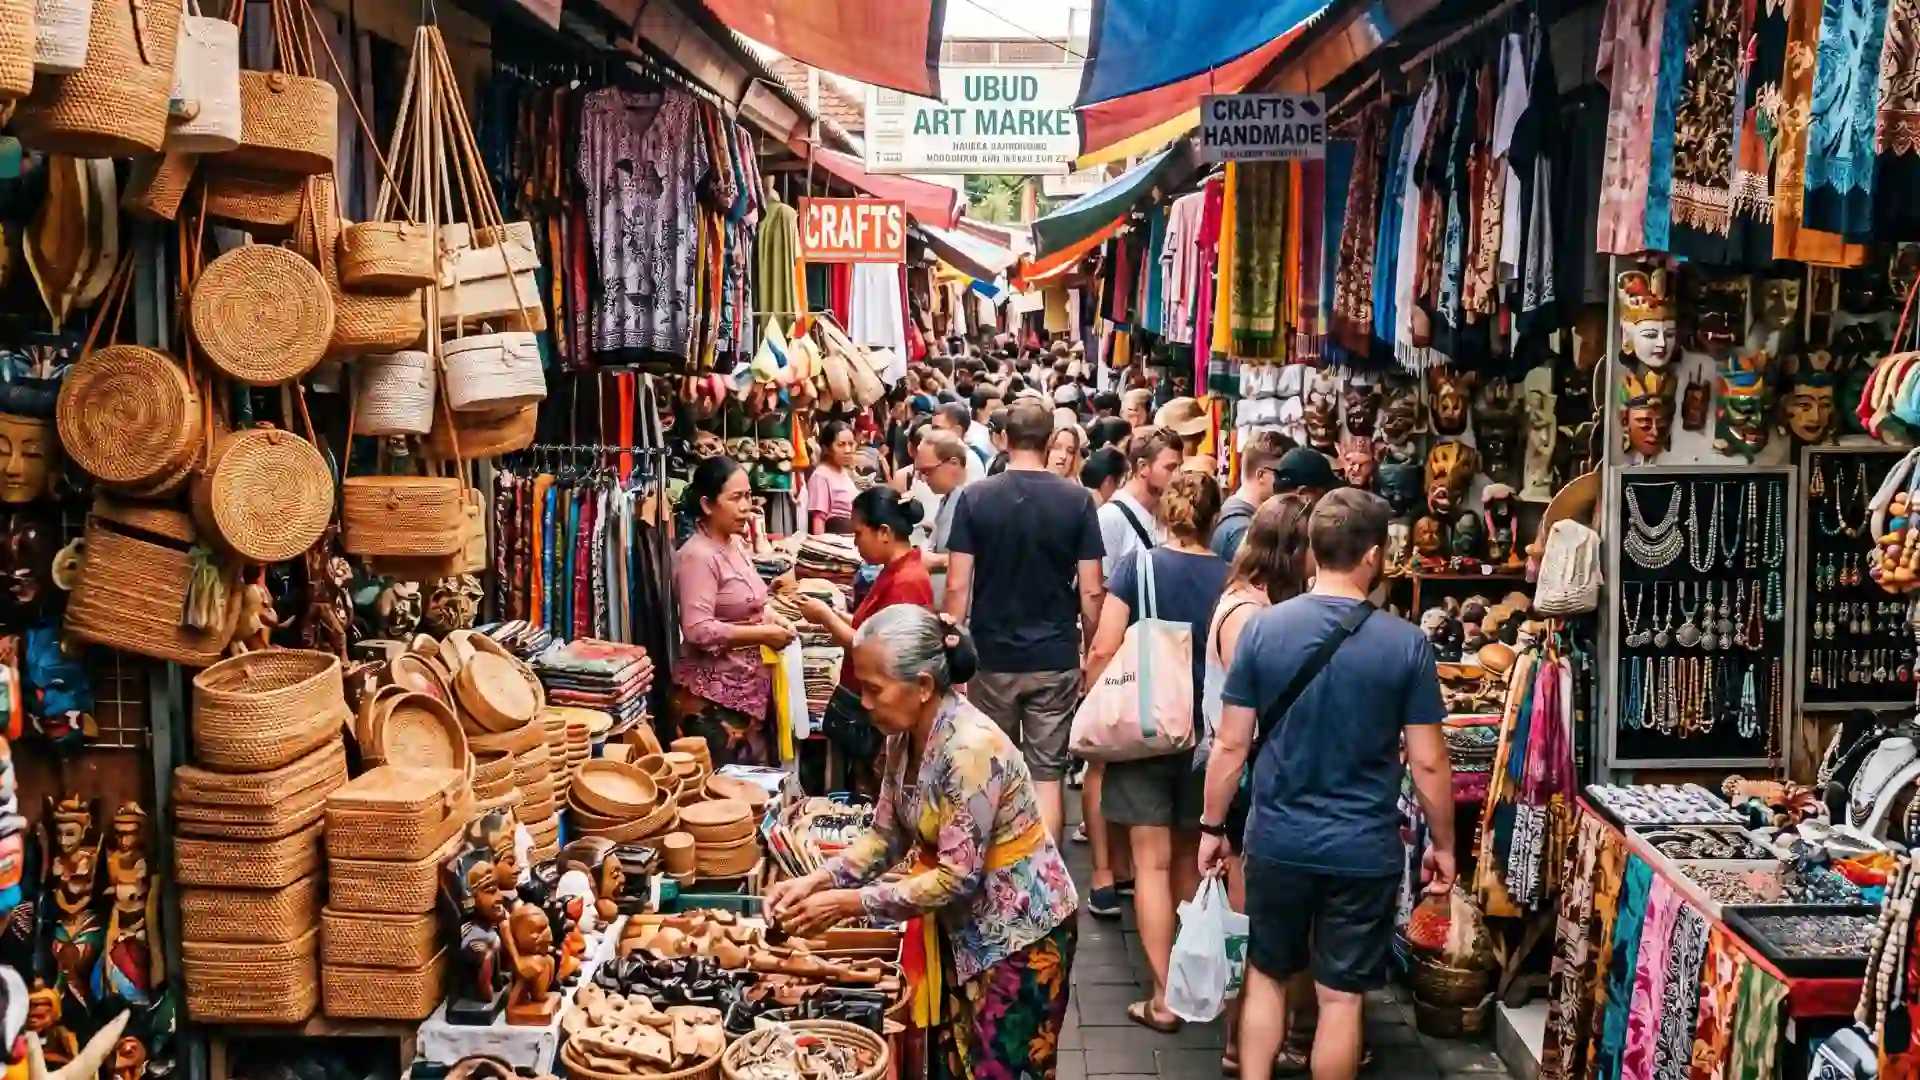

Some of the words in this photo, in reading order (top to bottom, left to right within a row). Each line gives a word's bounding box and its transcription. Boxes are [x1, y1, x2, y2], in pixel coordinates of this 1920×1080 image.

[964, 75, 1038, 102] UBUD
[913, 108, 966, 135] ART
[1213, 98, 1295, 121] CRAFTS
[1203, 122, 1323, 147] HANDMADE
[803, 203, 903, 250] CRAFTS
